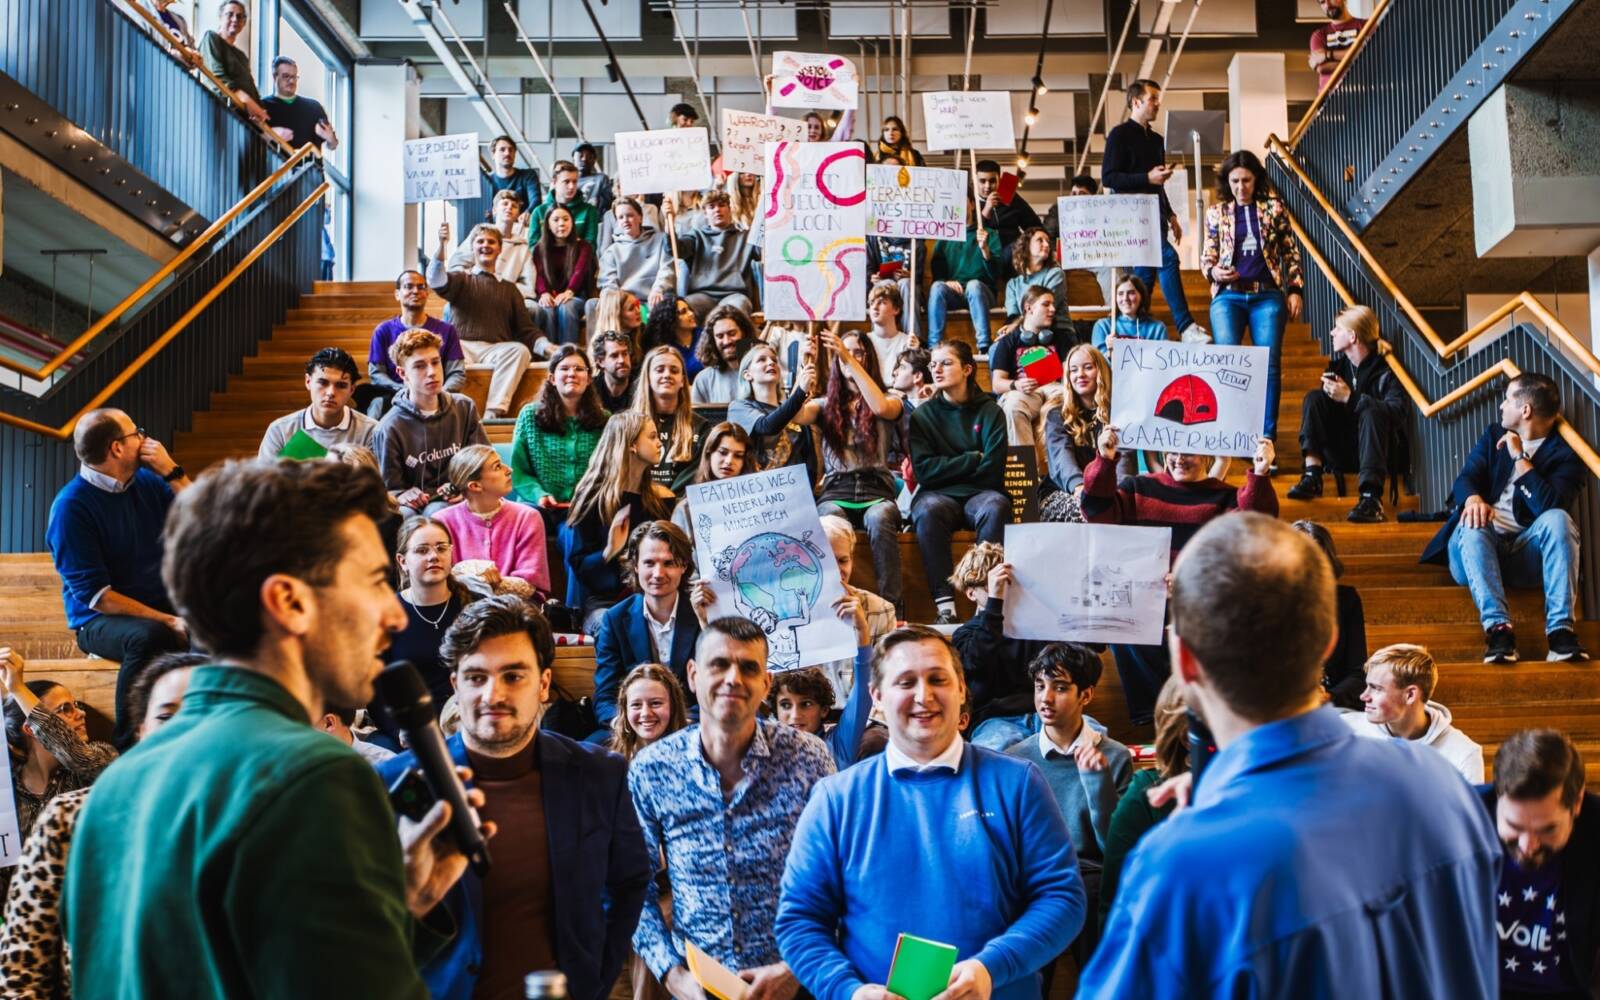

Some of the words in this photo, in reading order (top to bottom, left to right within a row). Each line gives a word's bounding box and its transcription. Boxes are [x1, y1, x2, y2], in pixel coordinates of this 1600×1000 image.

[416, 178, 476, 199] KANT
[876, 218, 894, 235] DE
[901, 219, 964, 239] TOEKOMST
[418, 441, 462, 464] Columb
[699, 476, 765, 503] FATBIKES
[766, 471, 797, 488] WEG
[722, 492, 786, 516] NEDERLAND
[1495, 918, 1552, 952] Volt
